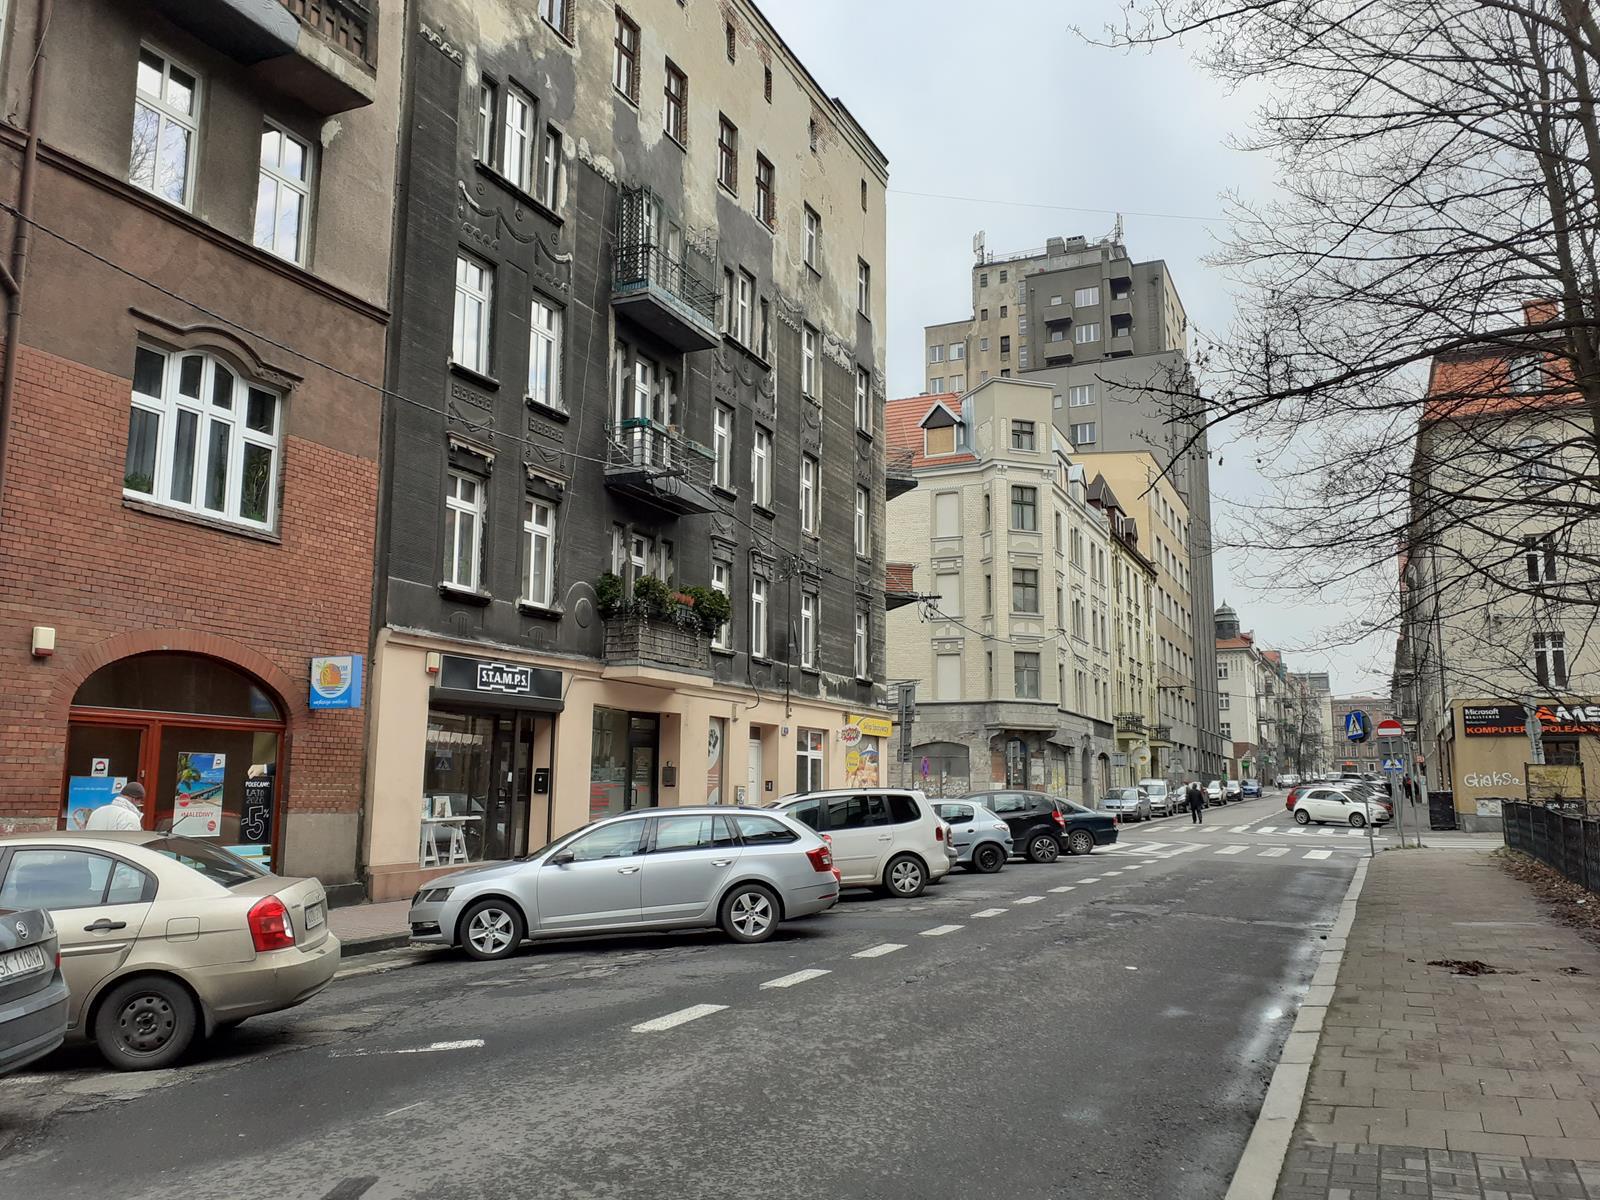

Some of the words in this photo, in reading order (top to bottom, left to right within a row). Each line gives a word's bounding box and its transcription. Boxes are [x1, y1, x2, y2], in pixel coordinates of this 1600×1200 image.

[481, 670, 528, 686] S.T.A.M.P.S.
[1466, 726, 1529, 734] KOMPUTER
[246, 788, 265, 797] LATO
